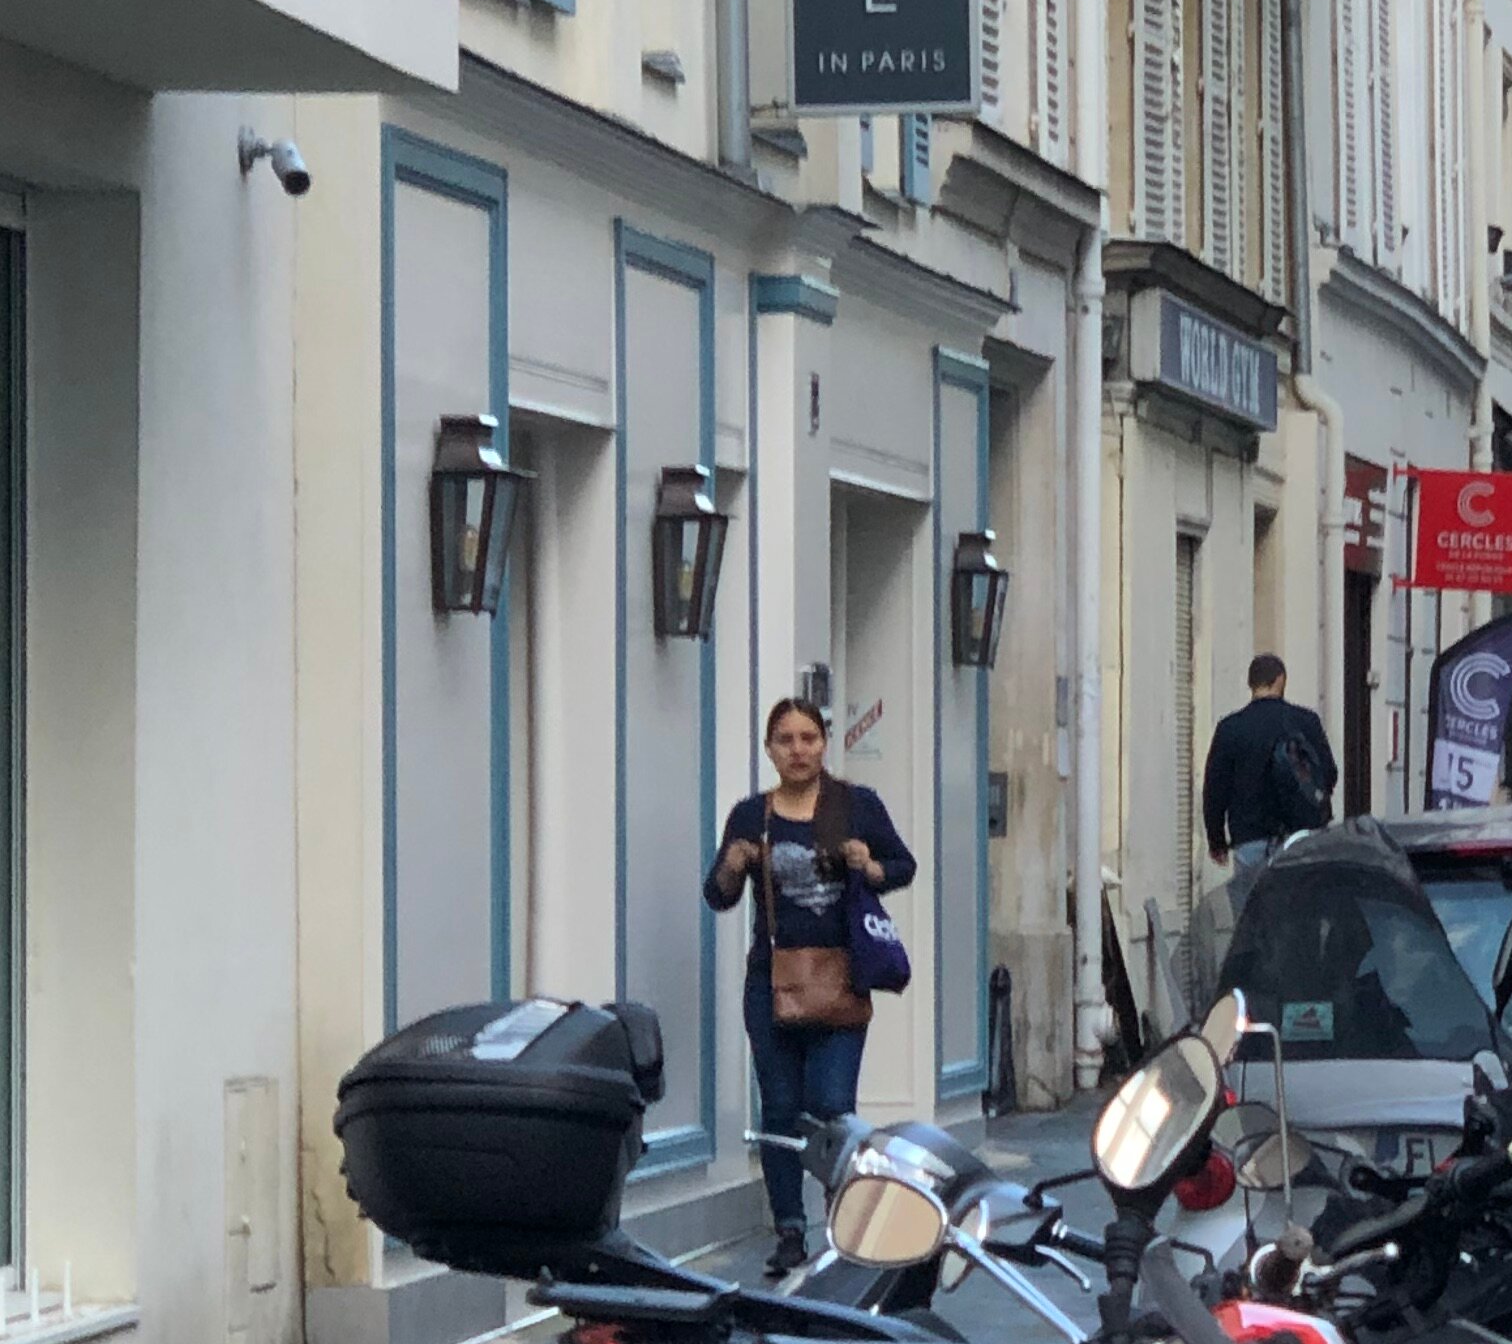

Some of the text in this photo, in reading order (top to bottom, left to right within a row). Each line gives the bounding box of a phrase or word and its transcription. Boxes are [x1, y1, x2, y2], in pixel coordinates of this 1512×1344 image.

[818, 47, 948, 73] IN PARIS
[1179, 311, 1261, 416] WORLD GYM
